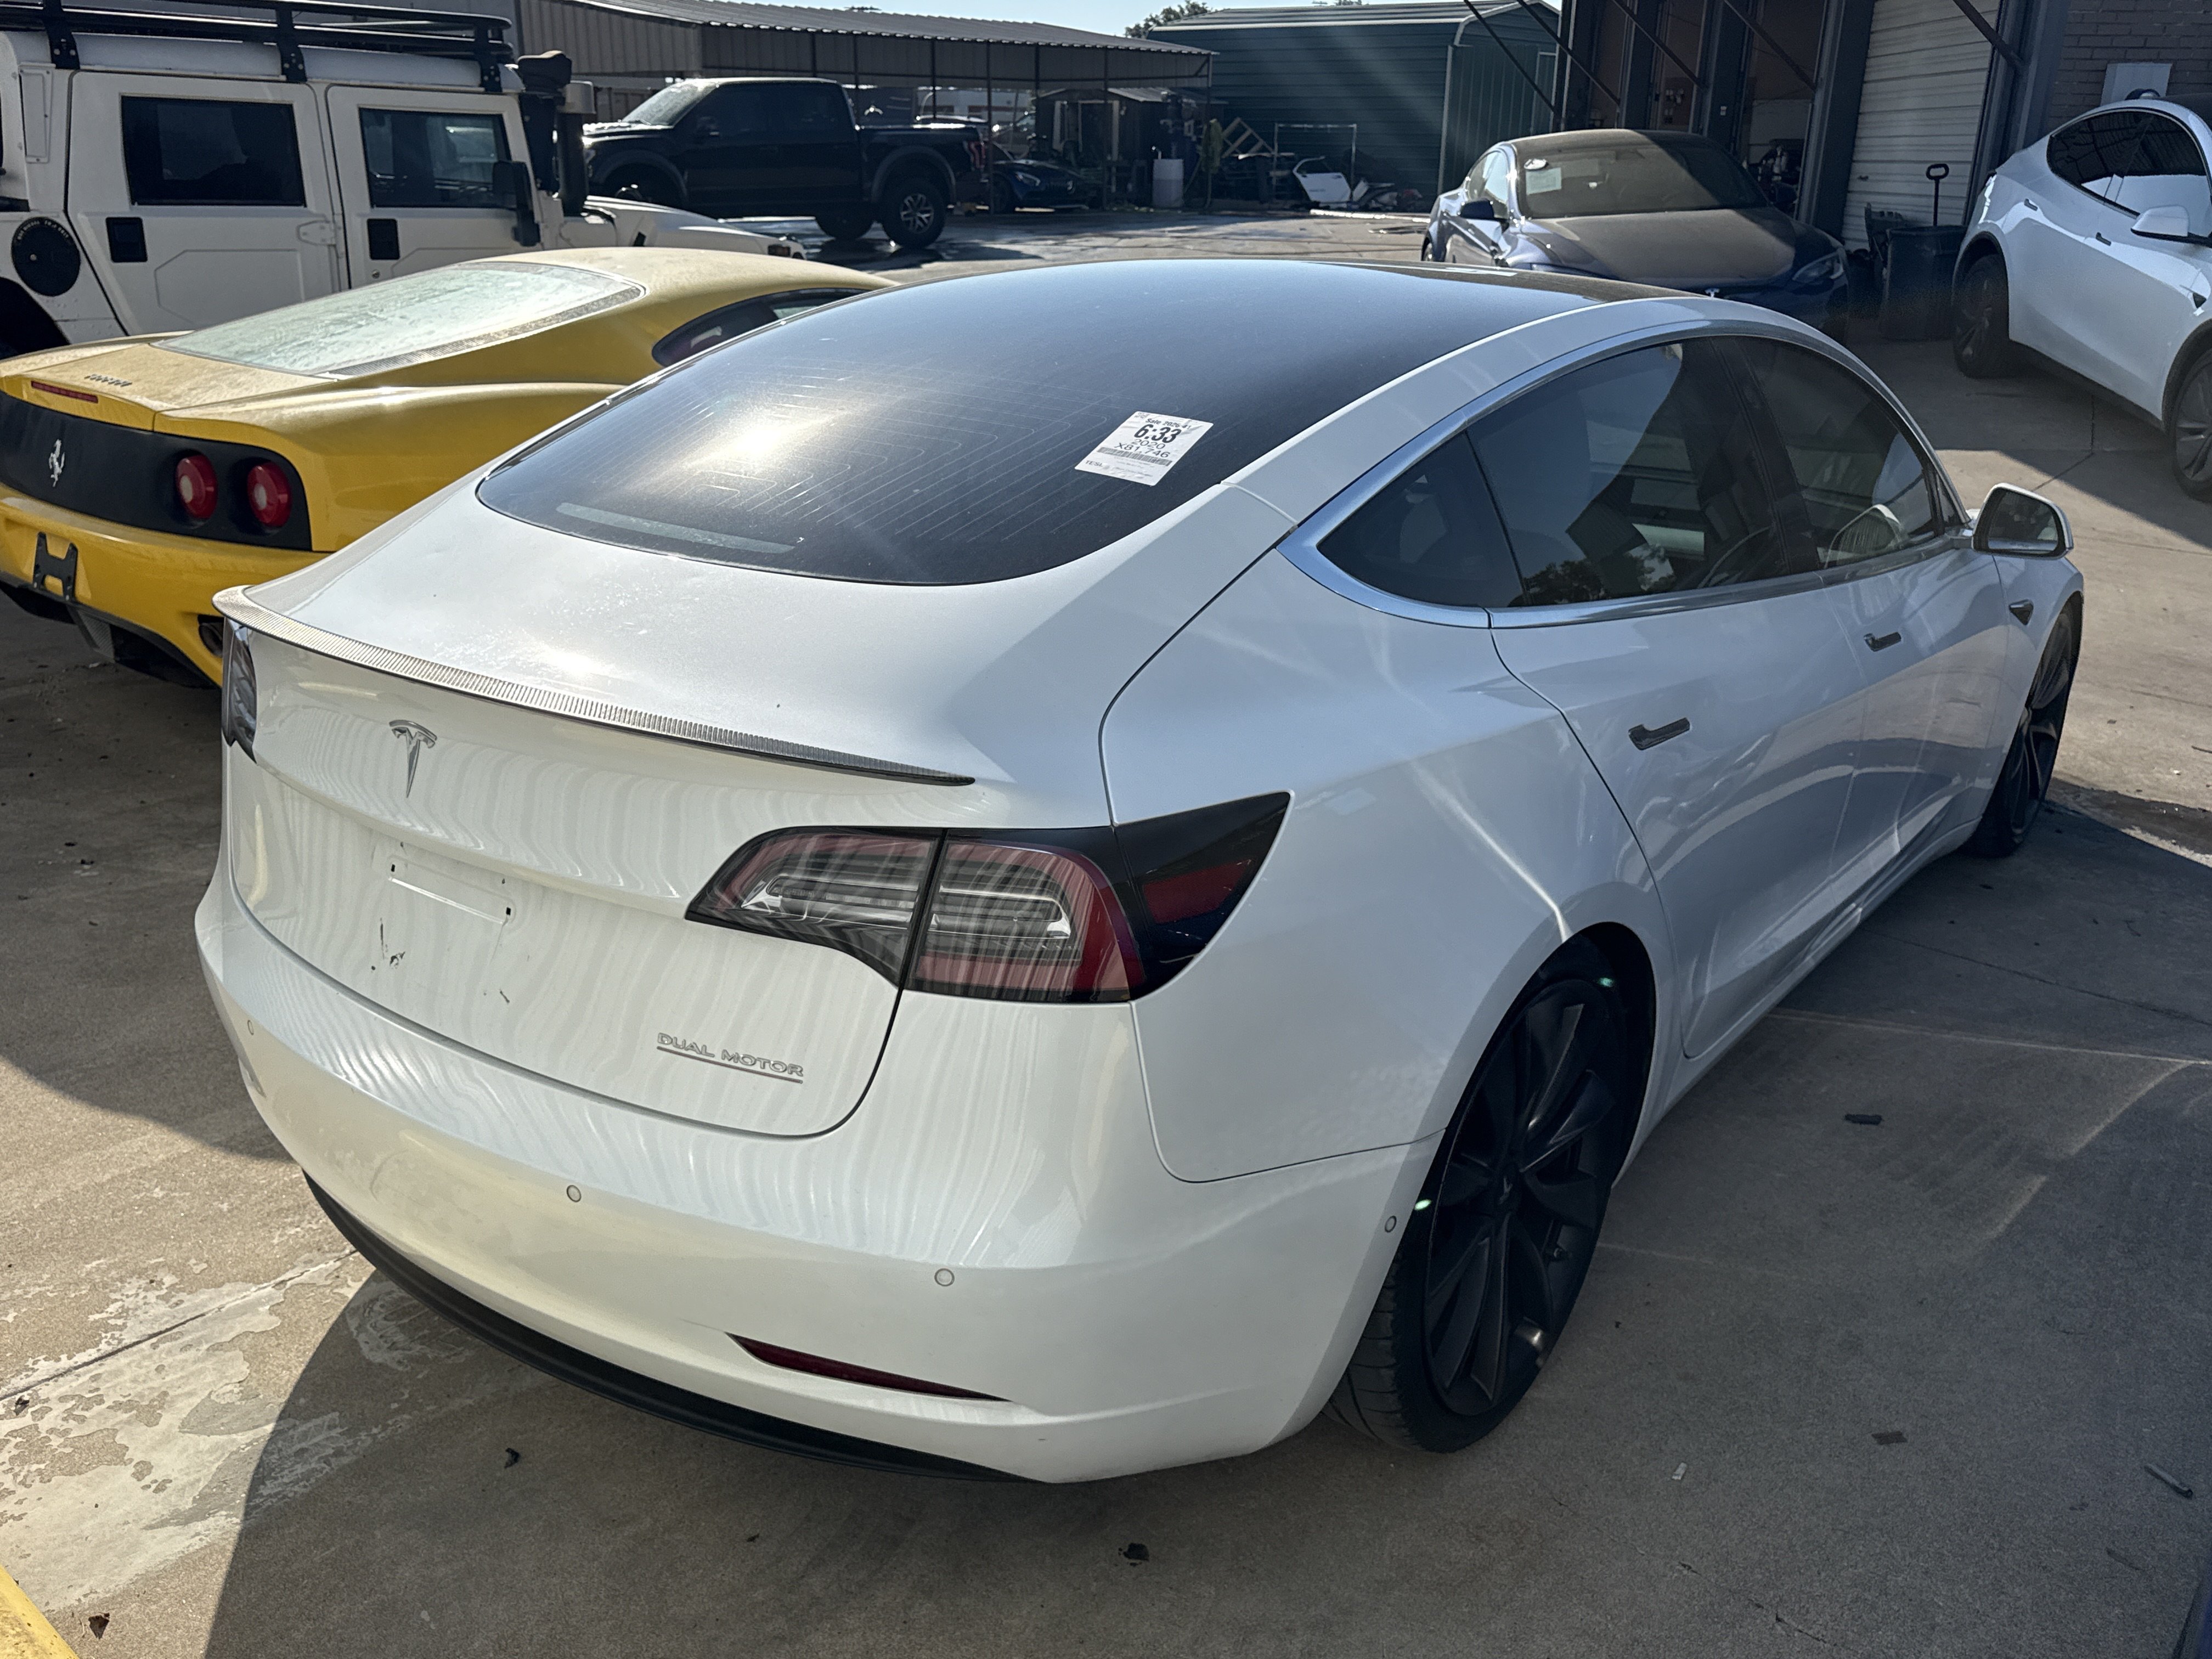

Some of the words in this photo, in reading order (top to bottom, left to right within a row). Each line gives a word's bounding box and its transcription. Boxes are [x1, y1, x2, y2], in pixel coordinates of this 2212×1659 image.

[1134, 424, 1182, 443] 6:33
[1131, 439, 1166, 449] 2020
[658, 1032, 715, 1058] DUAL
[721, 1049, 803, 1076] MOTOR
